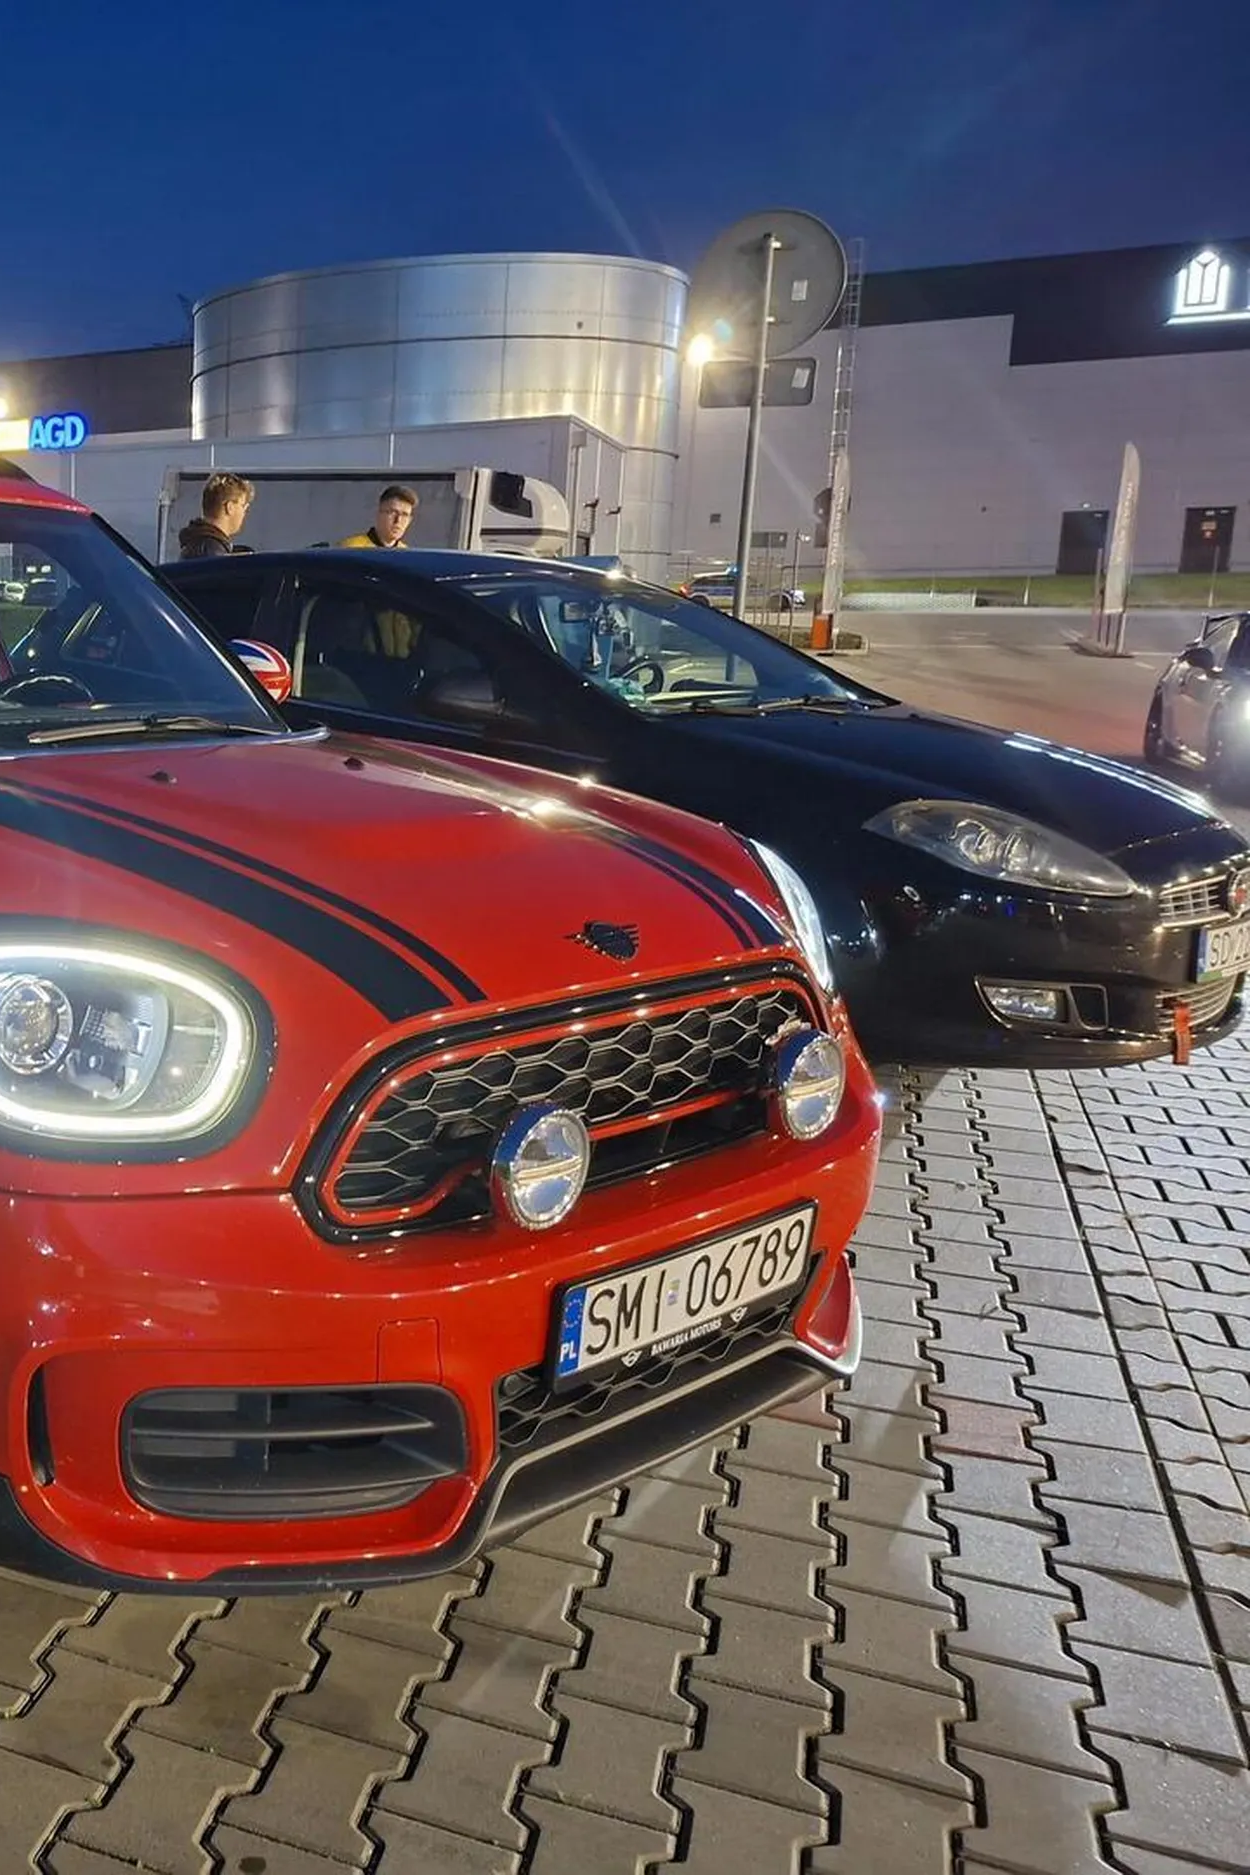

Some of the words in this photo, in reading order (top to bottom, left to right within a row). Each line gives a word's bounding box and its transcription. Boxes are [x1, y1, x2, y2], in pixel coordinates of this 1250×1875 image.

[28, 413, 87, 451] AGD
[585, 1270, 667, 1355] SMI
[685, 1218, 806, 1318] 06789
[558, 1346, 578, 1365] PL
